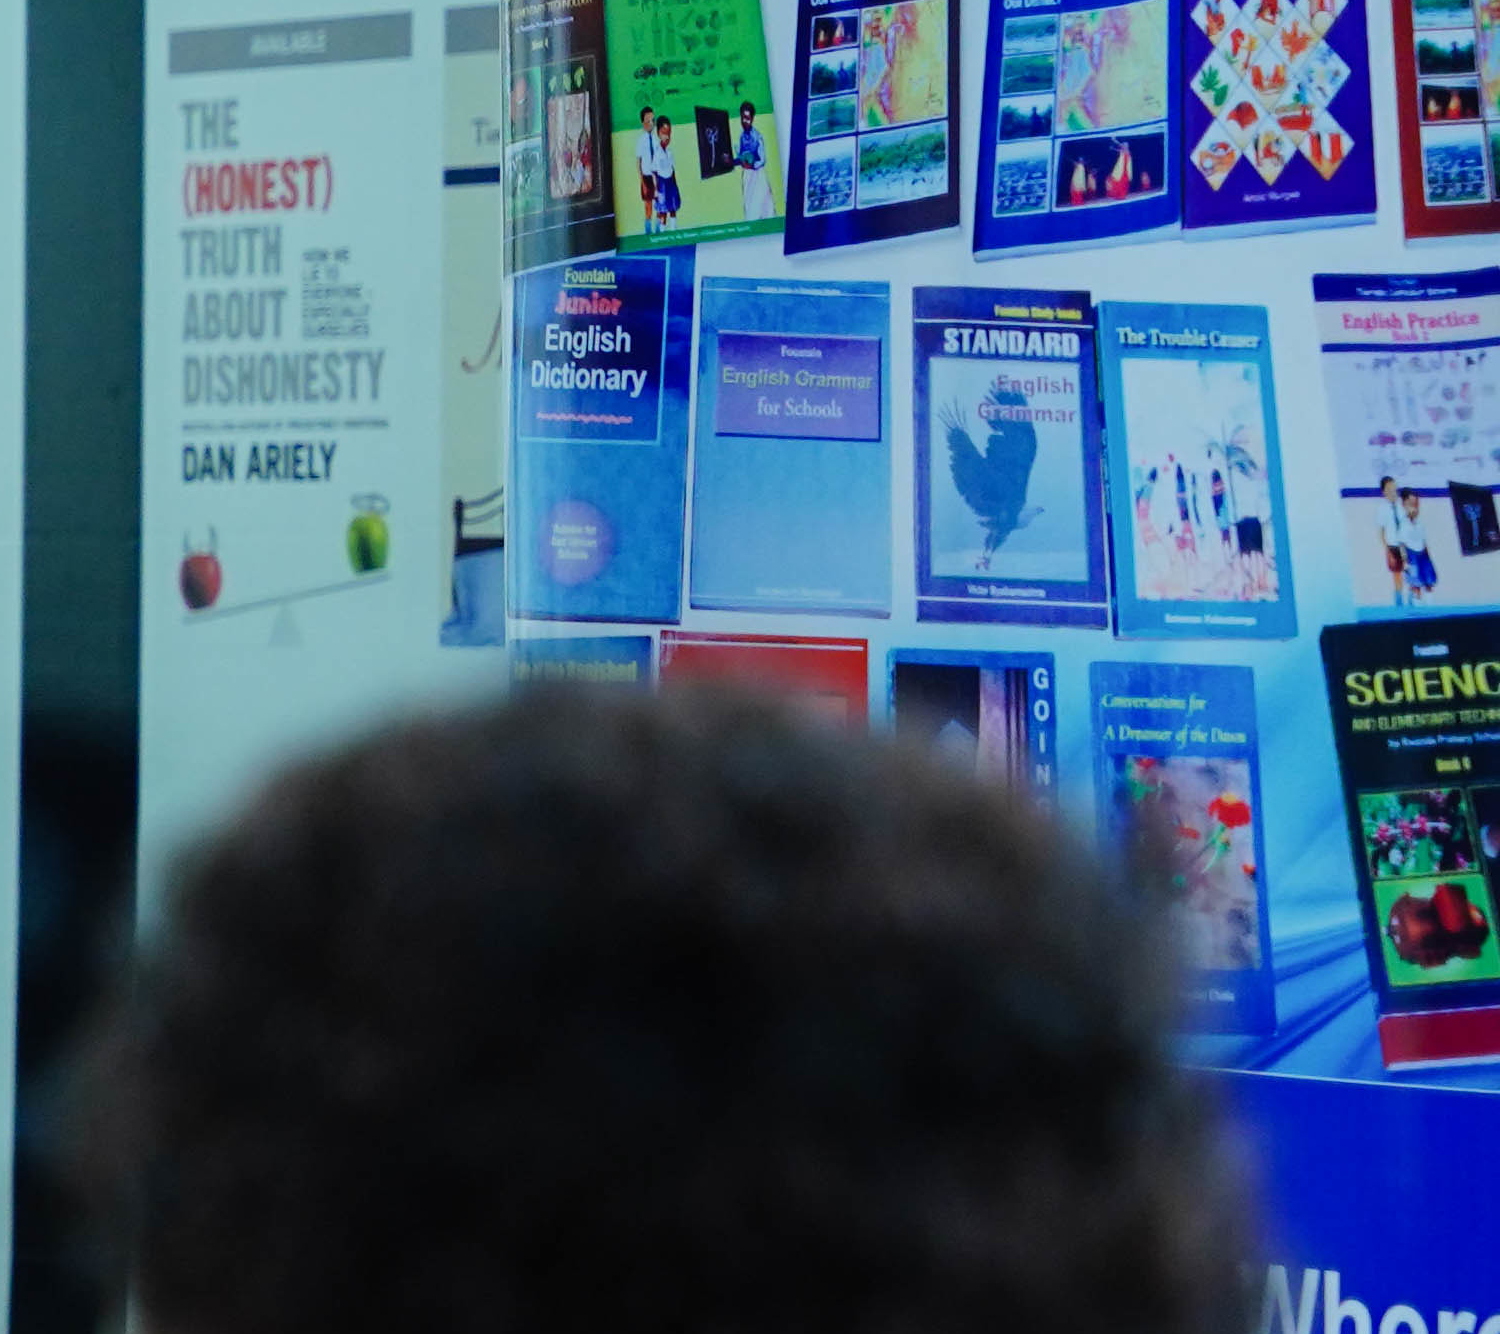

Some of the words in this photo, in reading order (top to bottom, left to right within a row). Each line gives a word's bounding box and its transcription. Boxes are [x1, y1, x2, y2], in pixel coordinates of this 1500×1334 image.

[181, 99, 239, 151] THE
[185, 153, 332, 218] (HONEST)
[181, 226, 283, 279] TRUTH
[564, 267, 616, 284] Fountain
[182, 288, 288, 342] ABOUT
[555, 291, 622, 315] Junior
[1342, 313, 1403, 334] English
[1407, 311, 1480, 330] Practice
[545, 323, 631, 359] English
[943, 327, 1080, 358] STANDARD
[1116, 327, 1146, 345] The
[1150, 328, 1208, 347] Trouble
[184, 350, 386, 407] DISHONESTY
[531, 359, 648, 399] Dictionary
[723, 367, 790, 388] English
[795, 369, 873, 389] Grammar
[996, 374, 1075, 398] English
[757, 396, 781, 416] for
[784, 398, 843, 418] Schools
[978, 402, 1076, 424] Grammar
[182, 443, 235, 484] DAN
[247, 441, 337, 483] ARIELY
[1103, 724, 1115, 741] A
